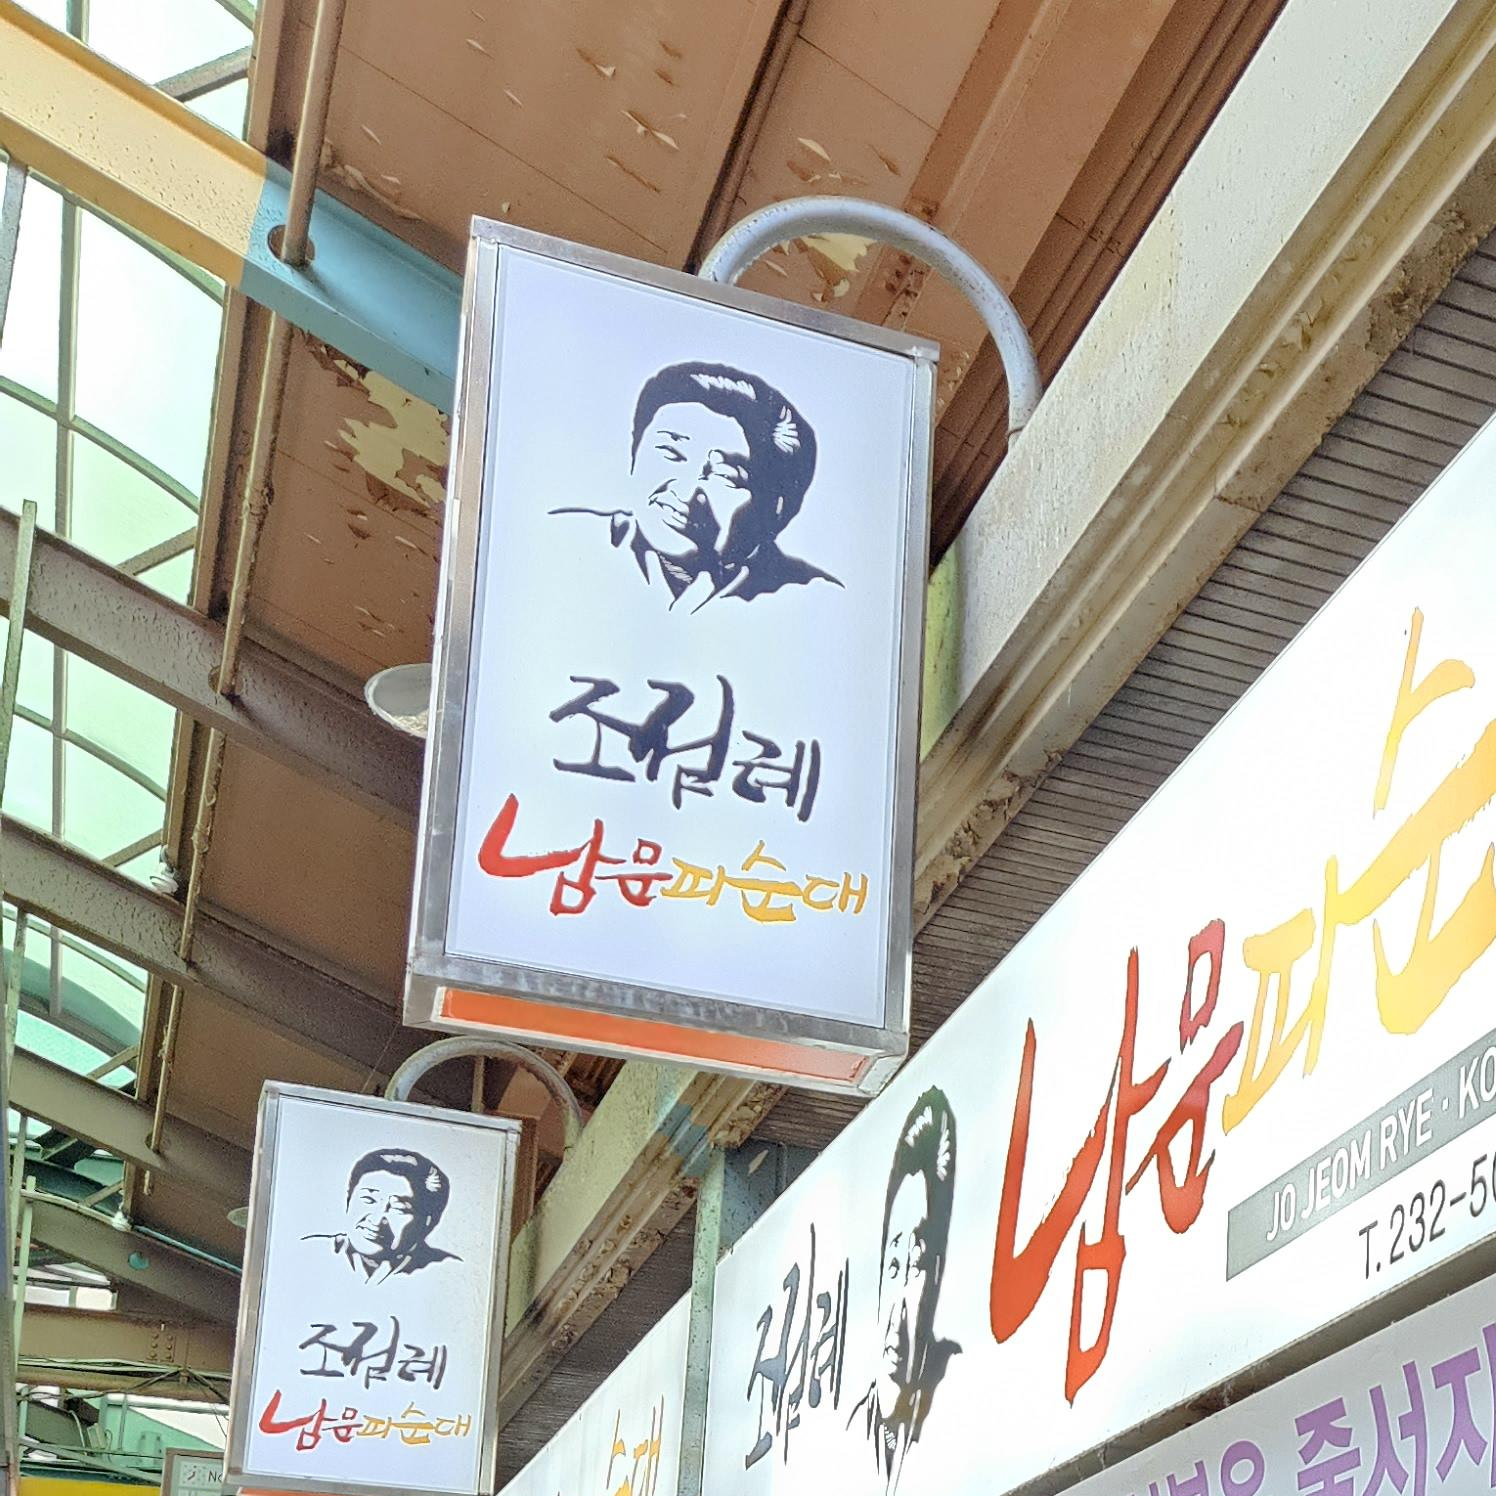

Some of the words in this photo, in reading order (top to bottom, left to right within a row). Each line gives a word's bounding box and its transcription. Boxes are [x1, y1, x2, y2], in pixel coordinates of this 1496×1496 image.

[549, 674, 821, 823] 조점례
[1266, 1183, 1296, 1243] JO
[1299, 1129, 1373, 1220] JEOM
[1377, 1089, 1434, 1171] RYE
